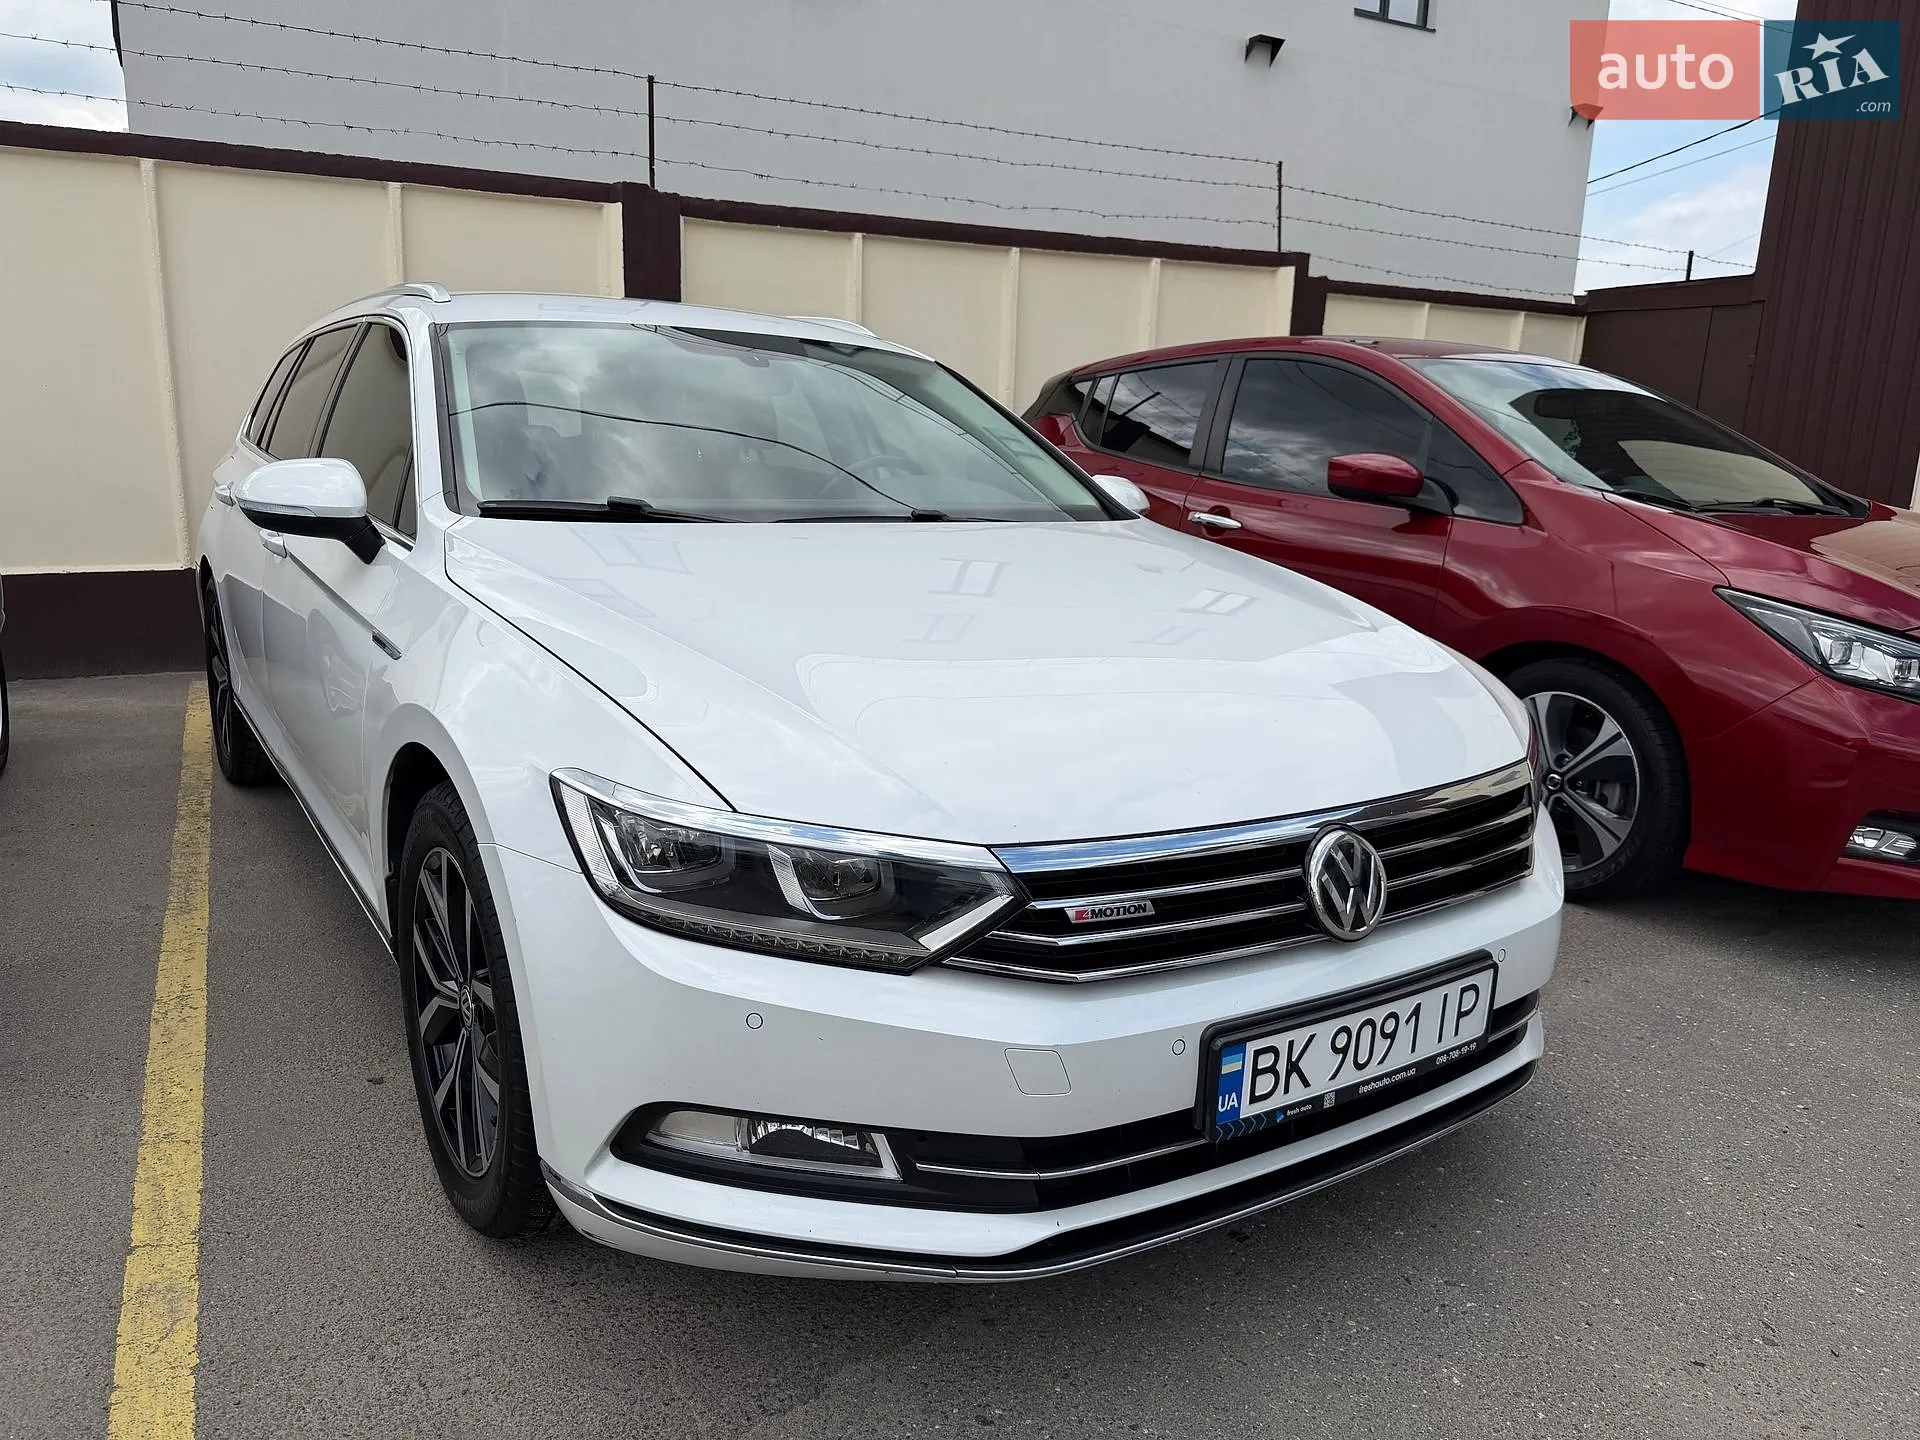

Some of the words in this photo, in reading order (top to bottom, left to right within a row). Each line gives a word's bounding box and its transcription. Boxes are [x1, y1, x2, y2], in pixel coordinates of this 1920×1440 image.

[1083, 903, 1147, 919] 4MOTION
[1249, 1032, 1317, 1105] BK
[1327, 1001, 1422, 1082] 9091
[1437, 982, 1480, 1044] IP
[1358, 1067, 1417, 1095] freshauto.com.ua
[1218, 1091, 1238, 1112] UA
